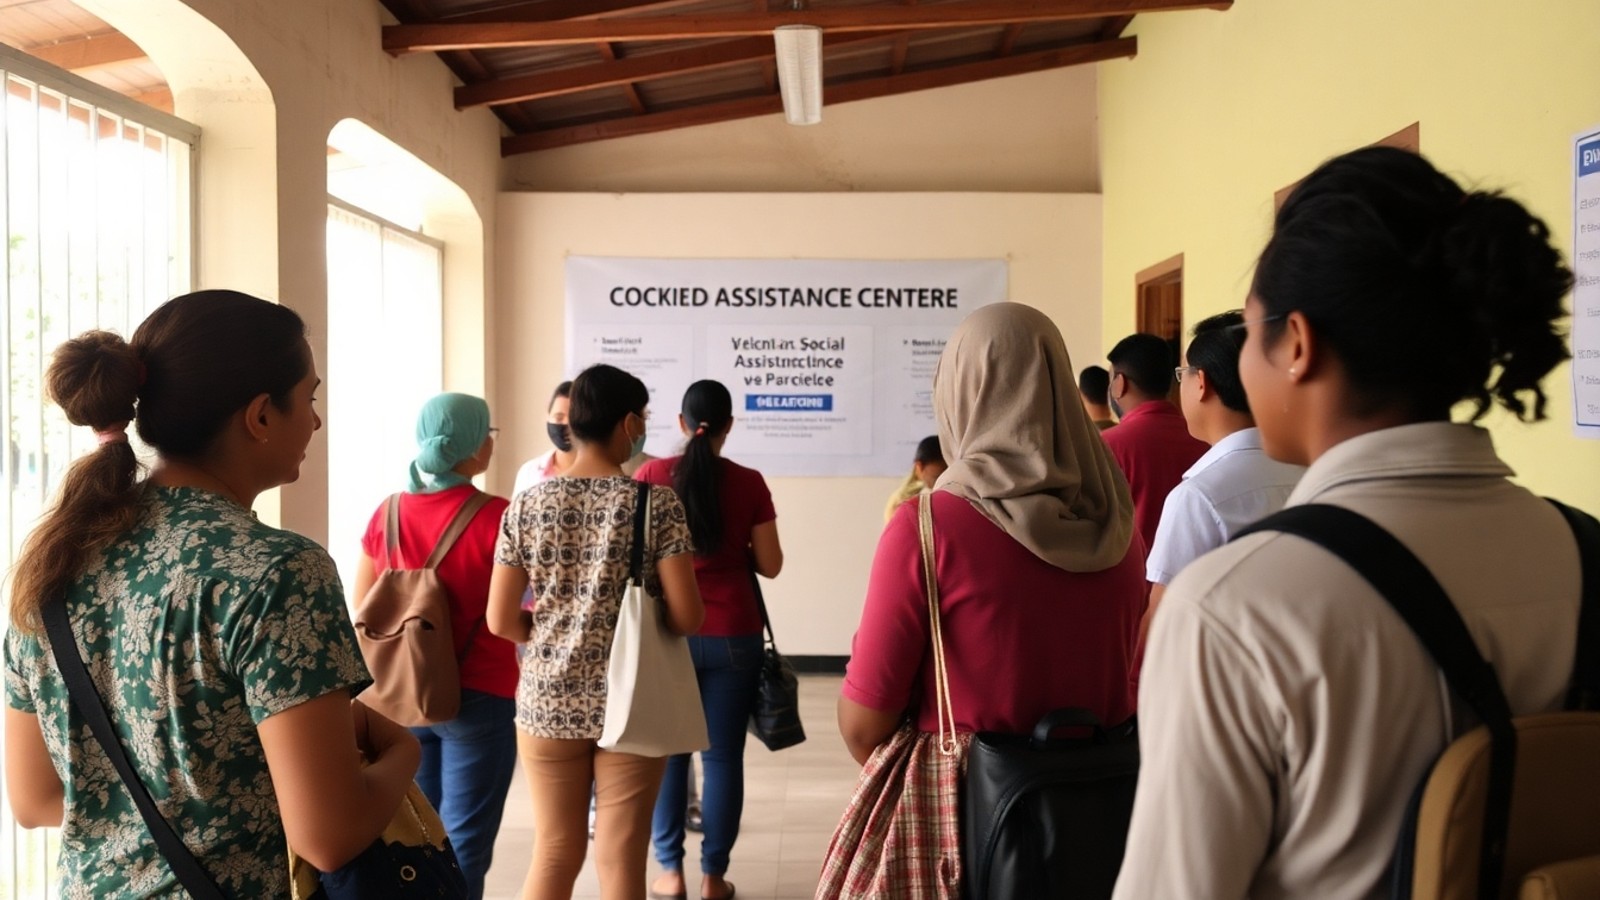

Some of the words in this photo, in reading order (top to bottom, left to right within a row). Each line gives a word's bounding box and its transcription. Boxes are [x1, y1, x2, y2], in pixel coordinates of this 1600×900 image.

[715, 287, 852, 308] ASSISTANCE
[857, 288, 958, 308] CENTERE
[800, 337, 845, 351] Social
